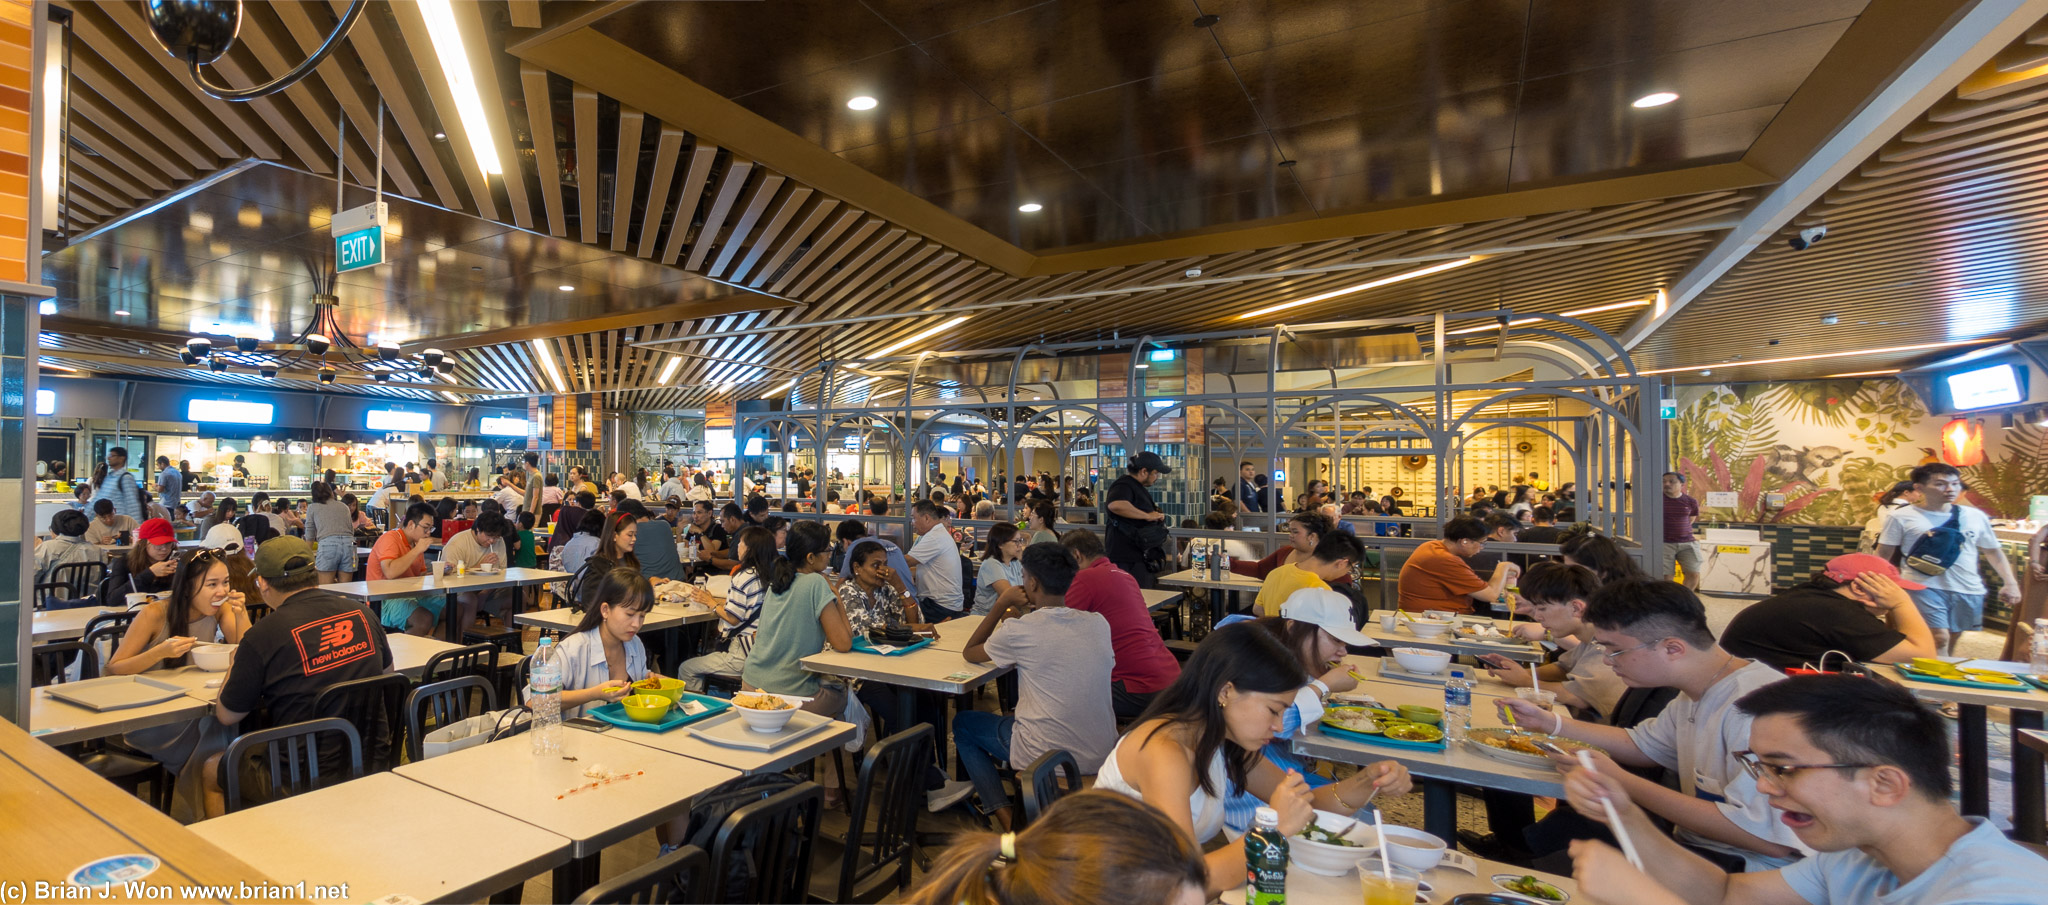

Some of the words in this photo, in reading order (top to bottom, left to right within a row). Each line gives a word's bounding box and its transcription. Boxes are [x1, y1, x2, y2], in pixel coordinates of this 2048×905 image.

[341, 235, 368, 266] EXIT
[318, 619, 354, 652] NB
[311, 652, 332, 666] new
[332, 640, 368, 659] balance
